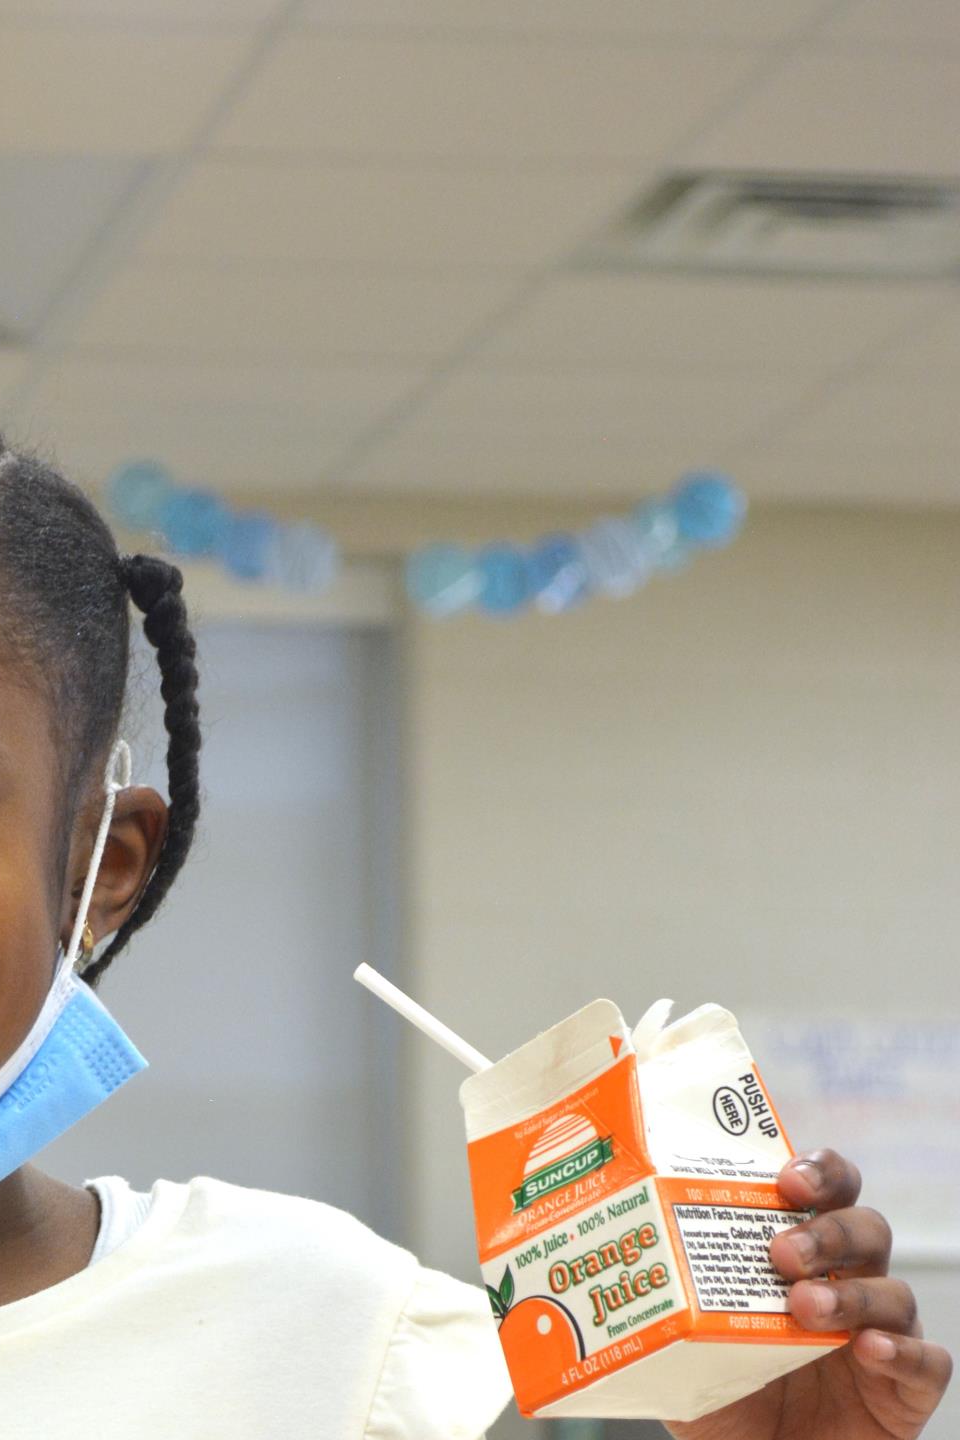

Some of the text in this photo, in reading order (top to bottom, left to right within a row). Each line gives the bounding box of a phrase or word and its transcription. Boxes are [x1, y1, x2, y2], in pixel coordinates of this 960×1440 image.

[719, 1093, 743, 1129] HERE
[738, 1073, 778, 1138] PUSH UP
[518, 1171, 607, 1228] ORANGE JUICE
[676, 1206, 711, 1220] Nutrition
[711, 1207, 733, 1220] Facts
[515, 1186, 650, 1270] 100% Juice 100% Natural
[730, 1227, 763, 1240] Calories
[549, 1222, 659, 1294] Orange
[589, 1263, 669, 1326] Juice
[607, 1299, 674, 1338] From Concentrate
[729, 1316, 750, 1329] FOOD
[751, 1317, 785, 1330] SERVICE
[568, 1365, 584, 1383] FL
[584, 1357, 601, 1375] OZ
